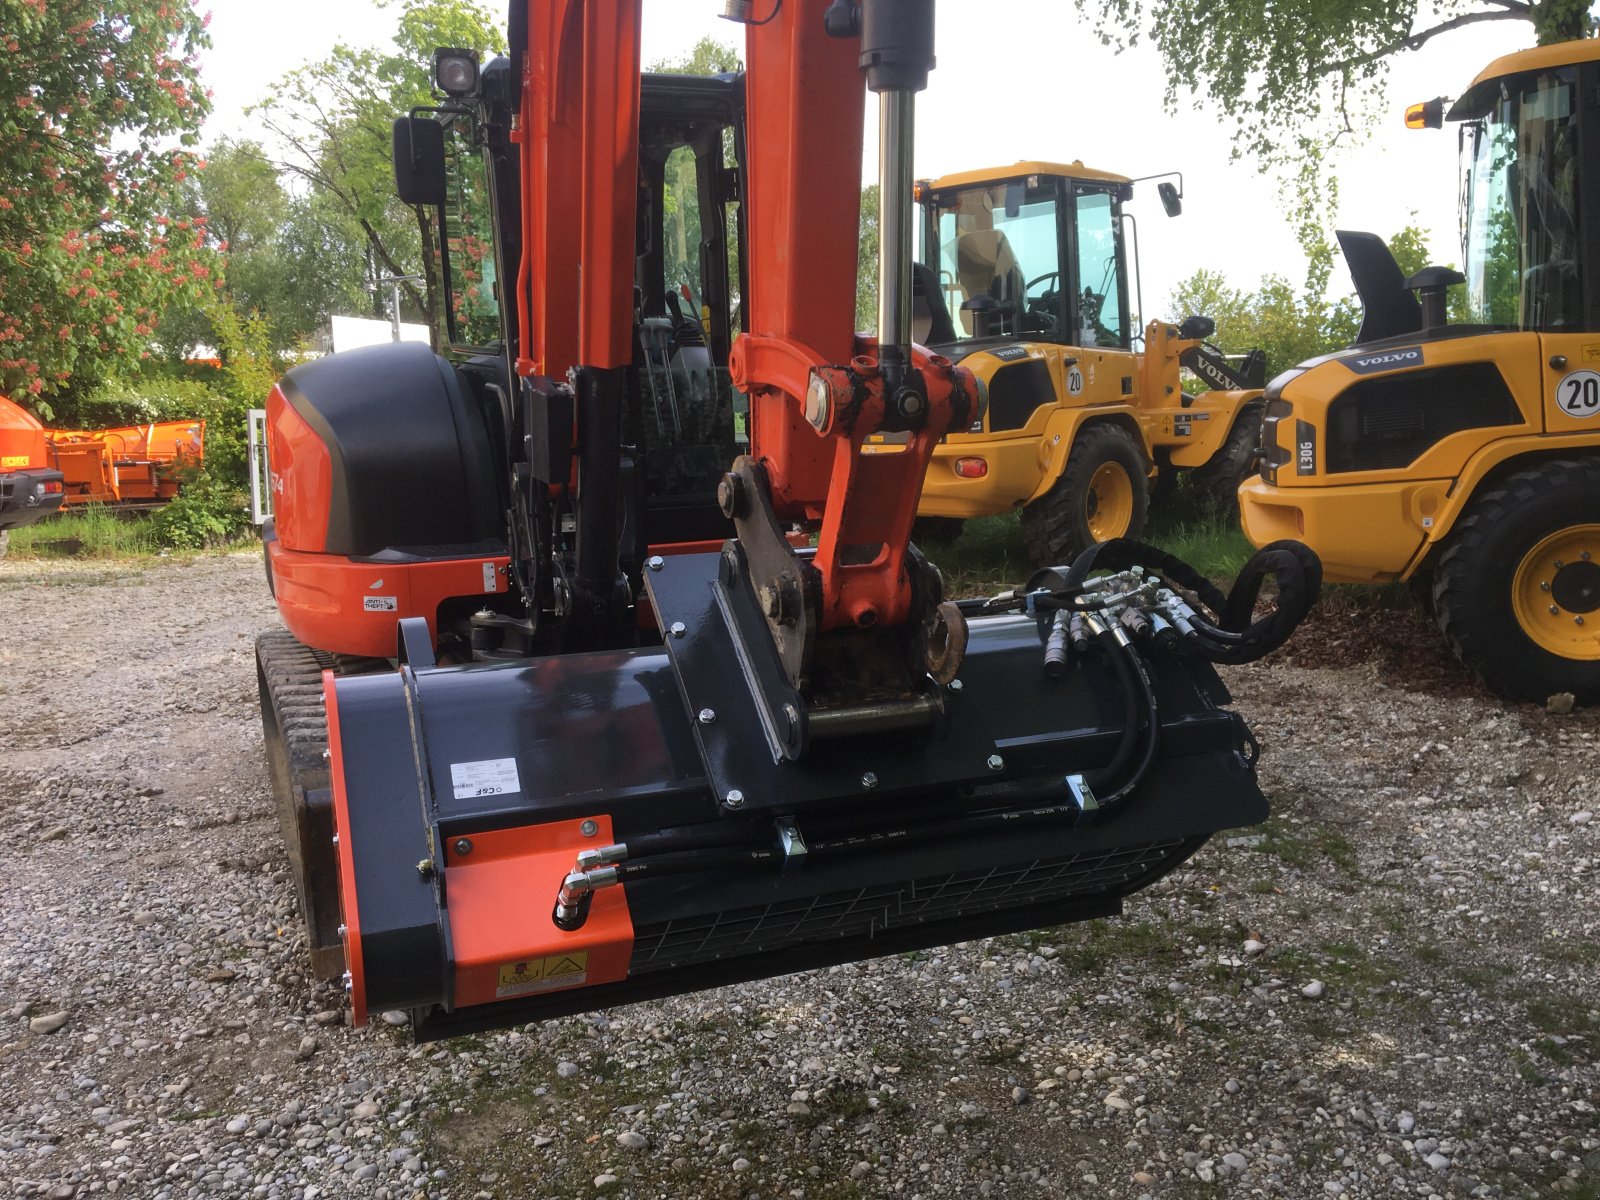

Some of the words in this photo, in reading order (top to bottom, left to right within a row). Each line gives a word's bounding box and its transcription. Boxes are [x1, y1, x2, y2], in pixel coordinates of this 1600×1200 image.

[997, 347, 1025, 358] VOLVO
[1358, 350, 1418, 367] VOLVO
[1069, 373, 1082, 391] 20
[1197, 355, 1244, 391] VOLVO
[1567, 379, 1598, 408] 20
[1300, 441, 1312, 470] L30G
[475, 787, 494, 796] C&F
